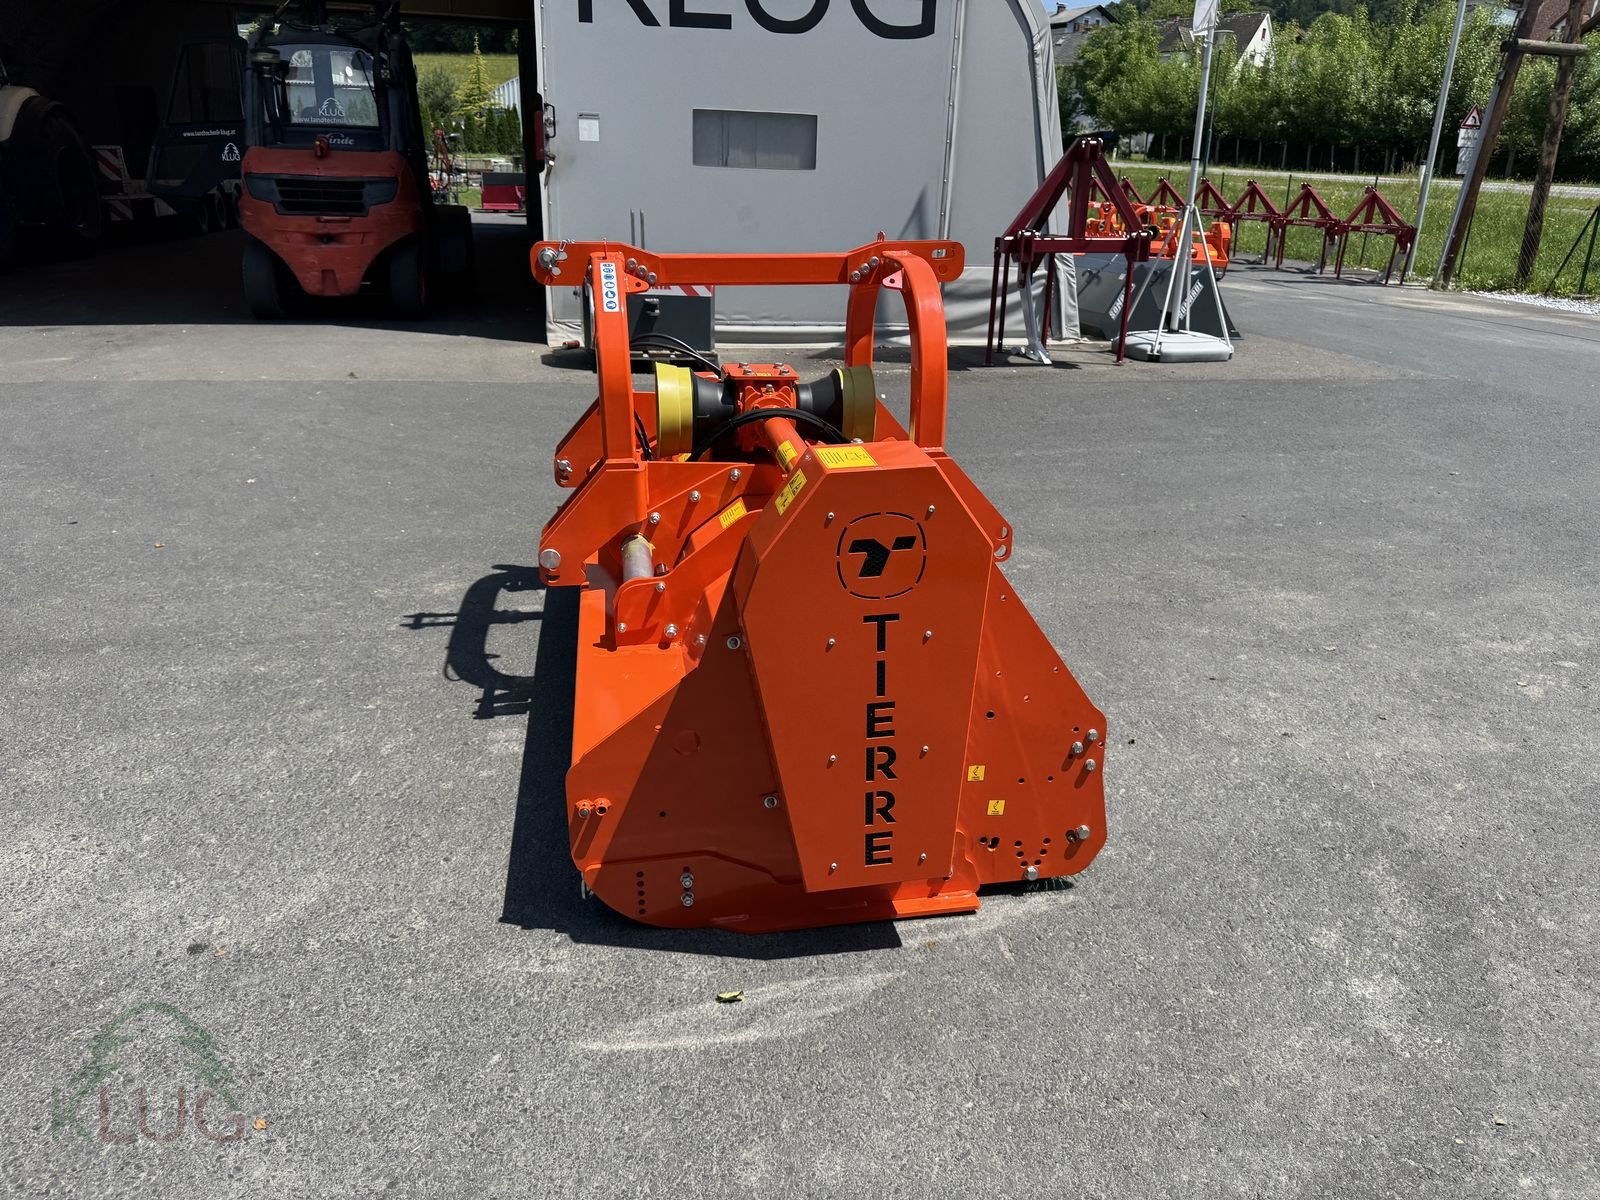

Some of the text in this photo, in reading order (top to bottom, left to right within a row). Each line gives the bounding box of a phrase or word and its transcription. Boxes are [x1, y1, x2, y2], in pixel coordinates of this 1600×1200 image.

[318, 108, 346, 117] KLUG
[221, 153, 241, 162] KLUG
[863, 612, 900, 867] TIERRE
